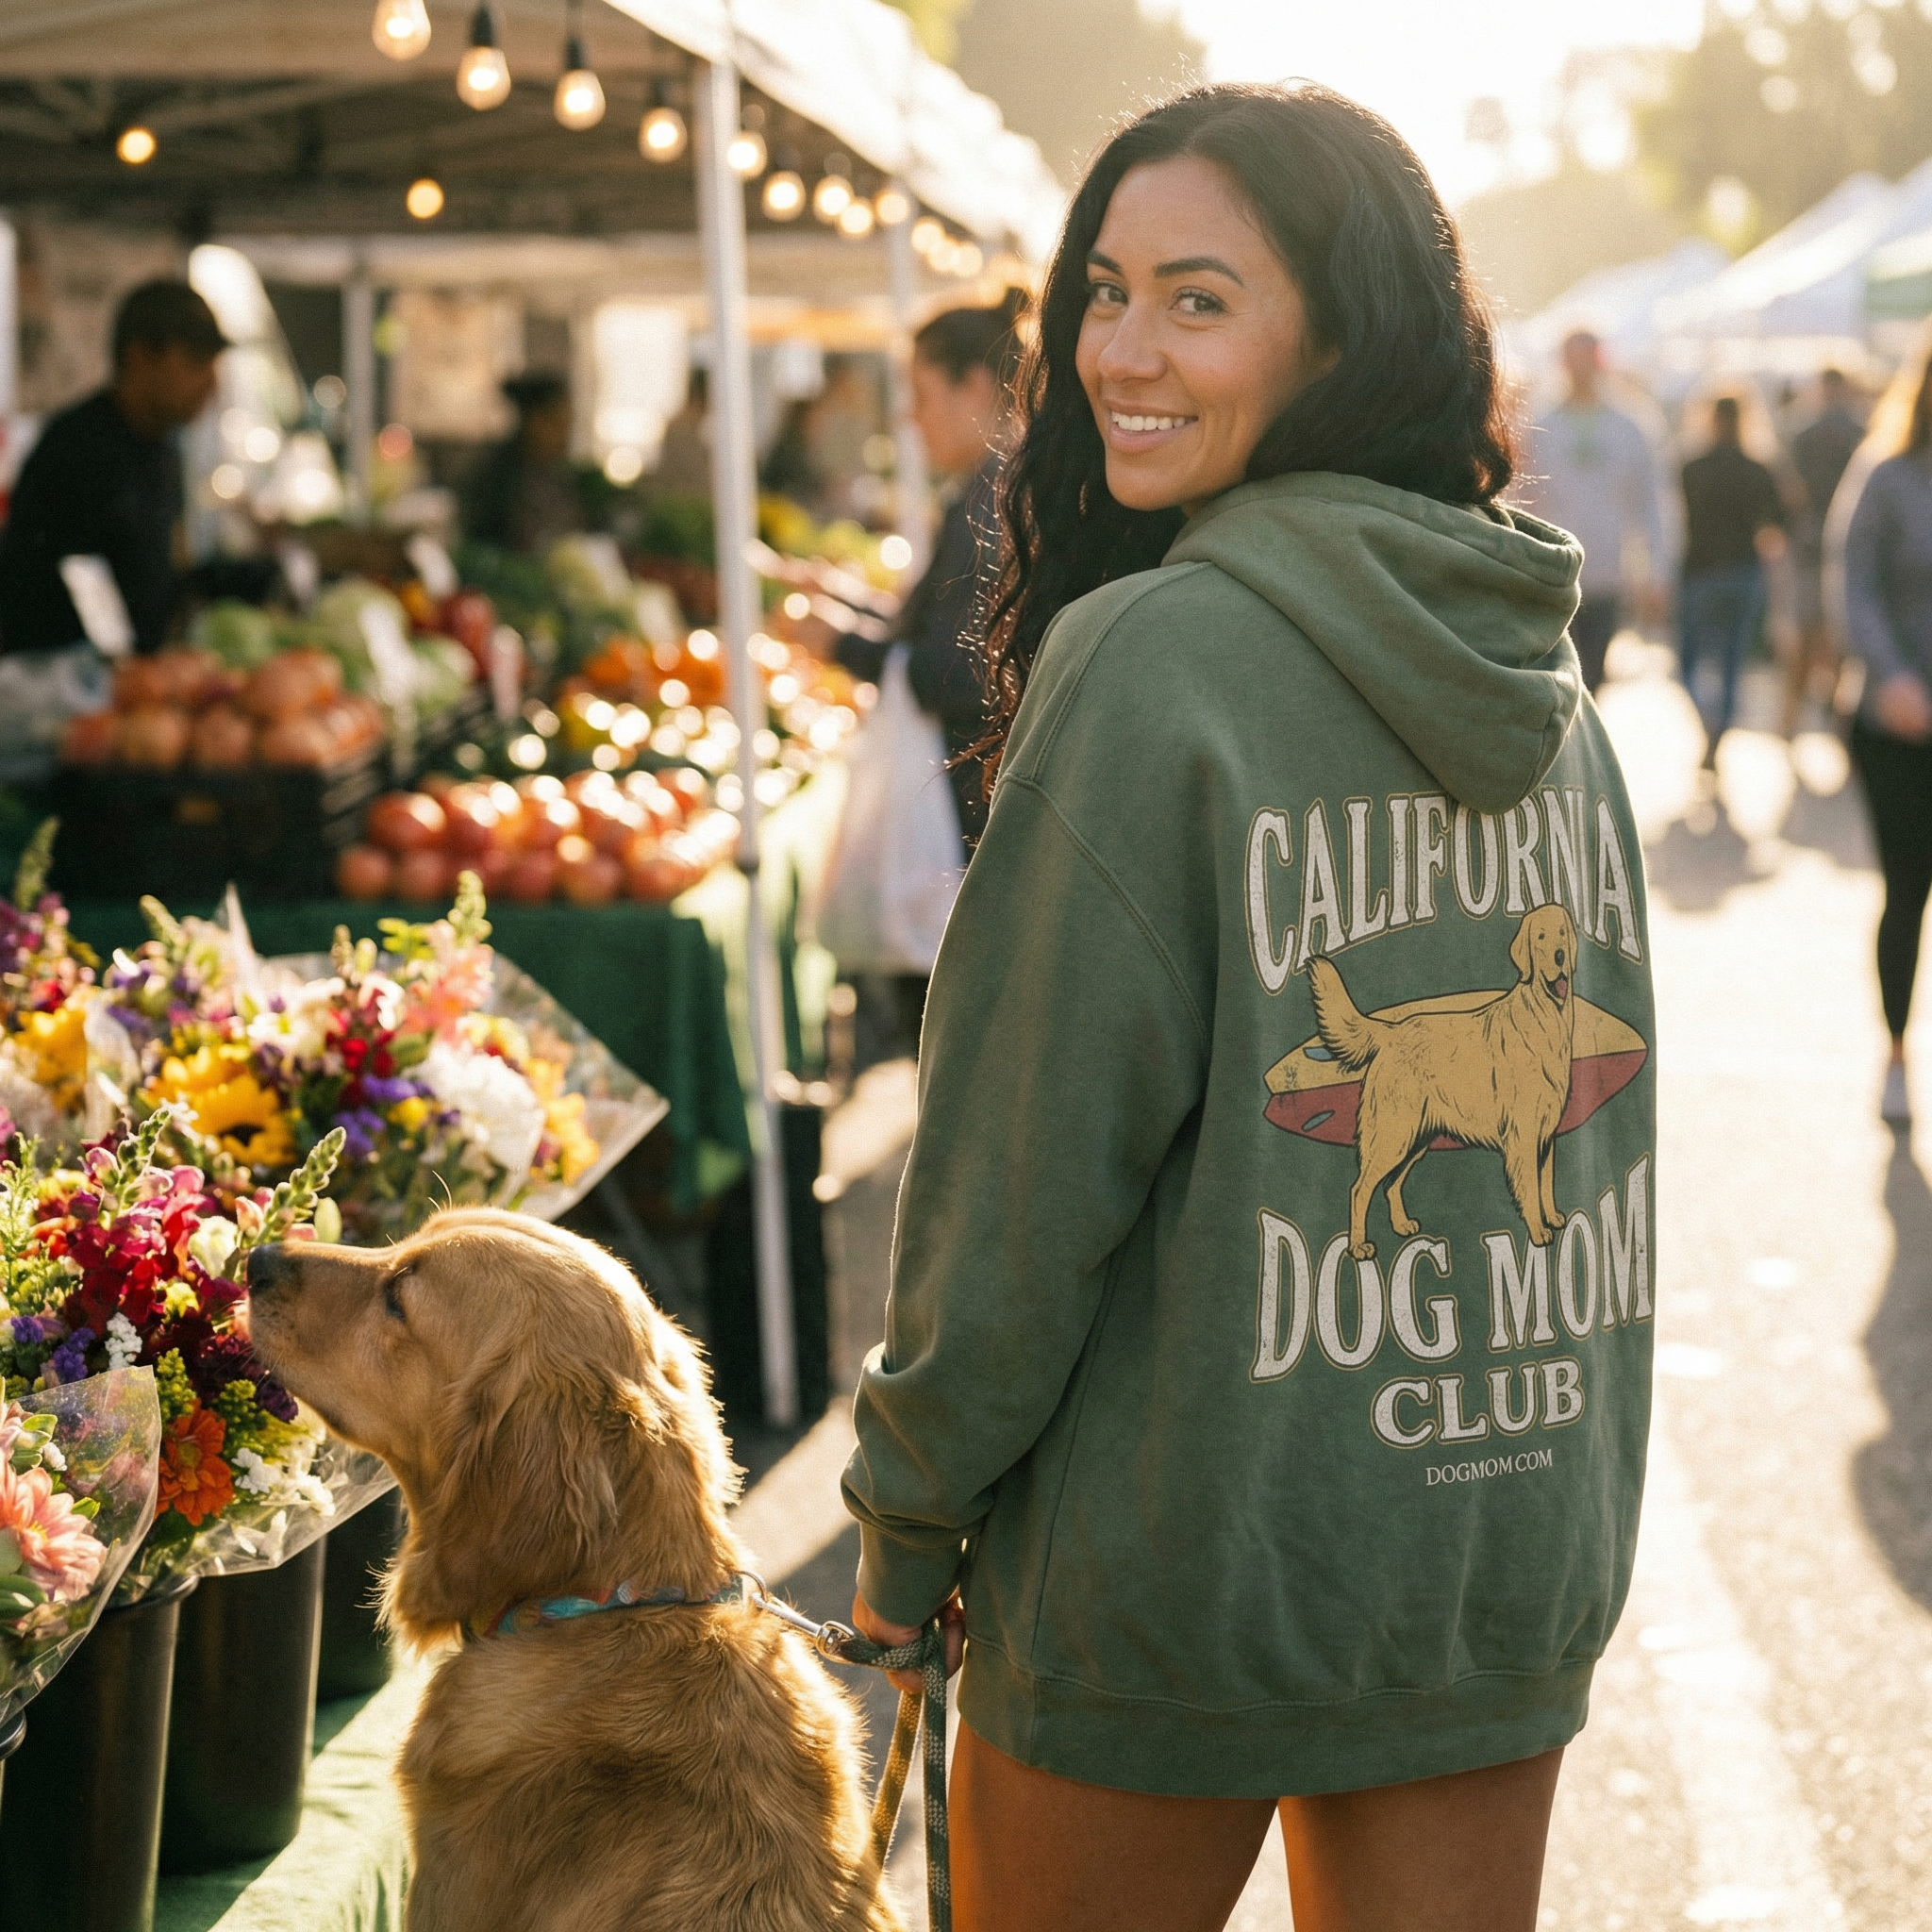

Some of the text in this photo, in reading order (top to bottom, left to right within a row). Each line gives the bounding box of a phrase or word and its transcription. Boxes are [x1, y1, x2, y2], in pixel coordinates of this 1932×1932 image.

[1244, 785, 1643, 996] CALIFORNIA
[1250, 1154, 1653, 1383] DOG MOM
[1371, 1356, 1585, 1449] CLUB
